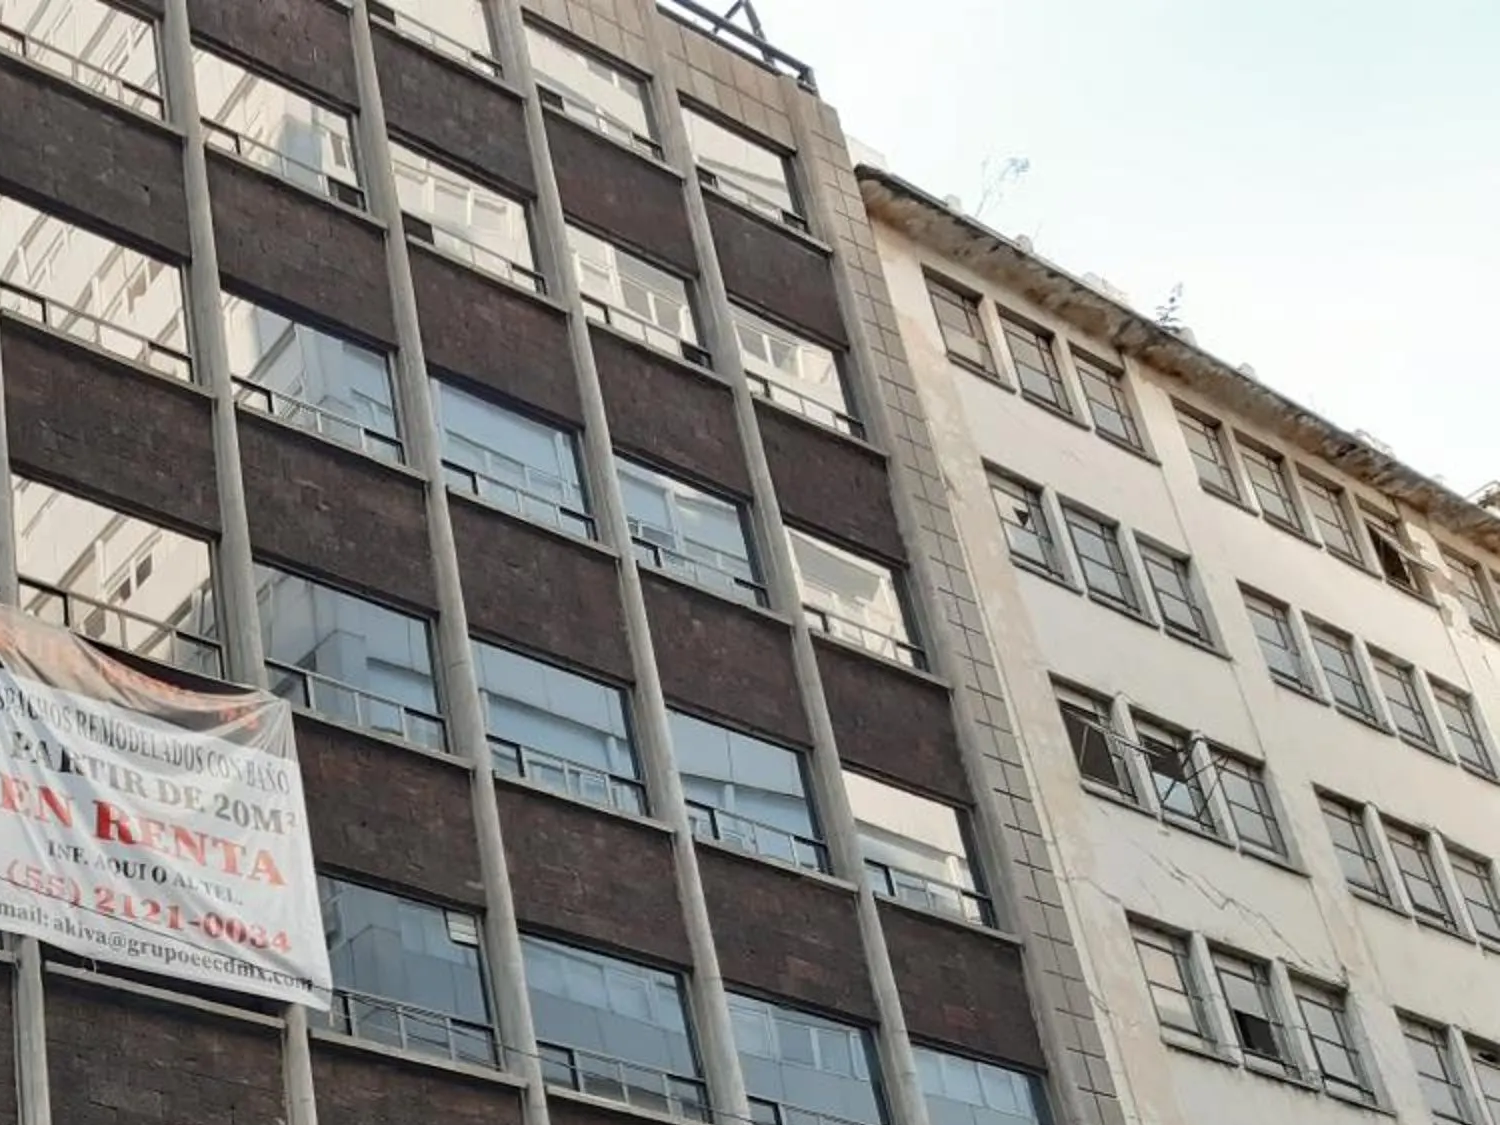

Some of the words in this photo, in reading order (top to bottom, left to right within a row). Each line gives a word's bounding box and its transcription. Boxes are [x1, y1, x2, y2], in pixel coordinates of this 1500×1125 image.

[11, 730, 150, 800] PARTIR
[156, 778, 204, 814] DE
[76, 709, 203, 774] REMODELADOS
[92, 798, 287, 888] RENTA
[95, 855, 147, 882] AQUI
[151, 865, 167, 884] O
[6, 859, 82, 909] (55)
[94, 883, 292, 954] 2121-0034
